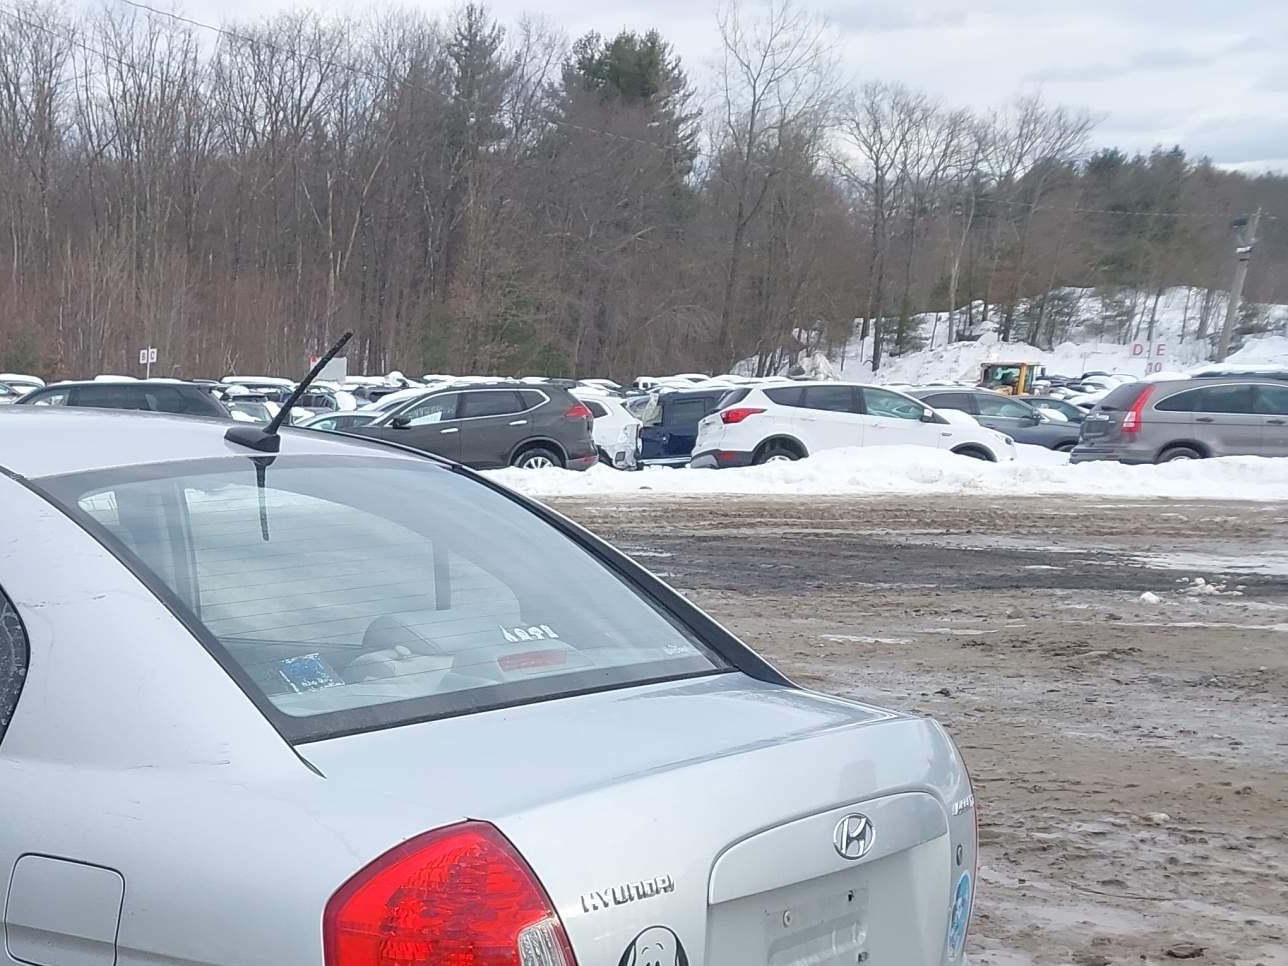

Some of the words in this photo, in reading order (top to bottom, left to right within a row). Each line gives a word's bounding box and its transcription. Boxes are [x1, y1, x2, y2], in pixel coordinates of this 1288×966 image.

[1132, 343, 1144, 356] D
[1156, 343, 1167, 356] E
[580, 873, 676, 914] HYUNDAI
